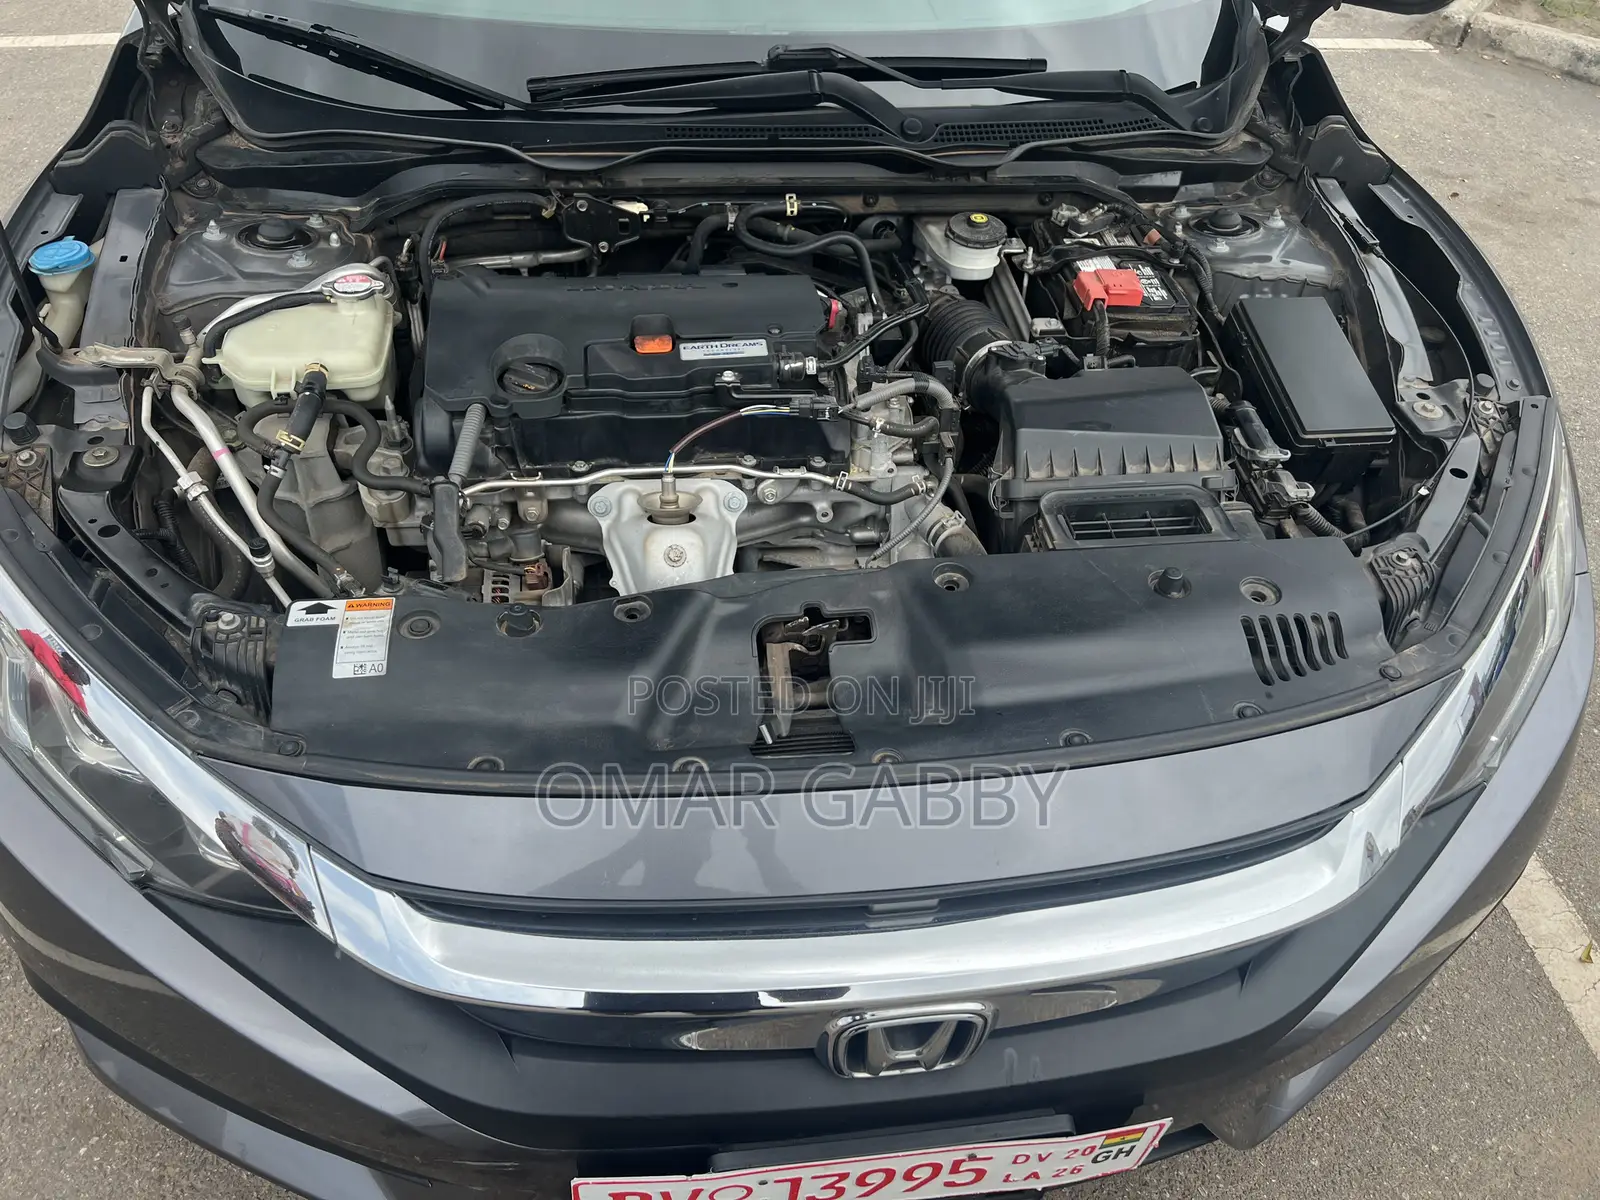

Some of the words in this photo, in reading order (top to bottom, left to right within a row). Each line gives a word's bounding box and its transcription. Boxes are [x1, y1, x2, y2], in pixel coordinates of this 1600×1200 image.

[1011, 1152, 1053, 1165] DV
[1064, 1145, 1098, 1160] 20
[1091, 1144, 1137, 1164] GH
[774, 1155, 994, 1200] 13995
